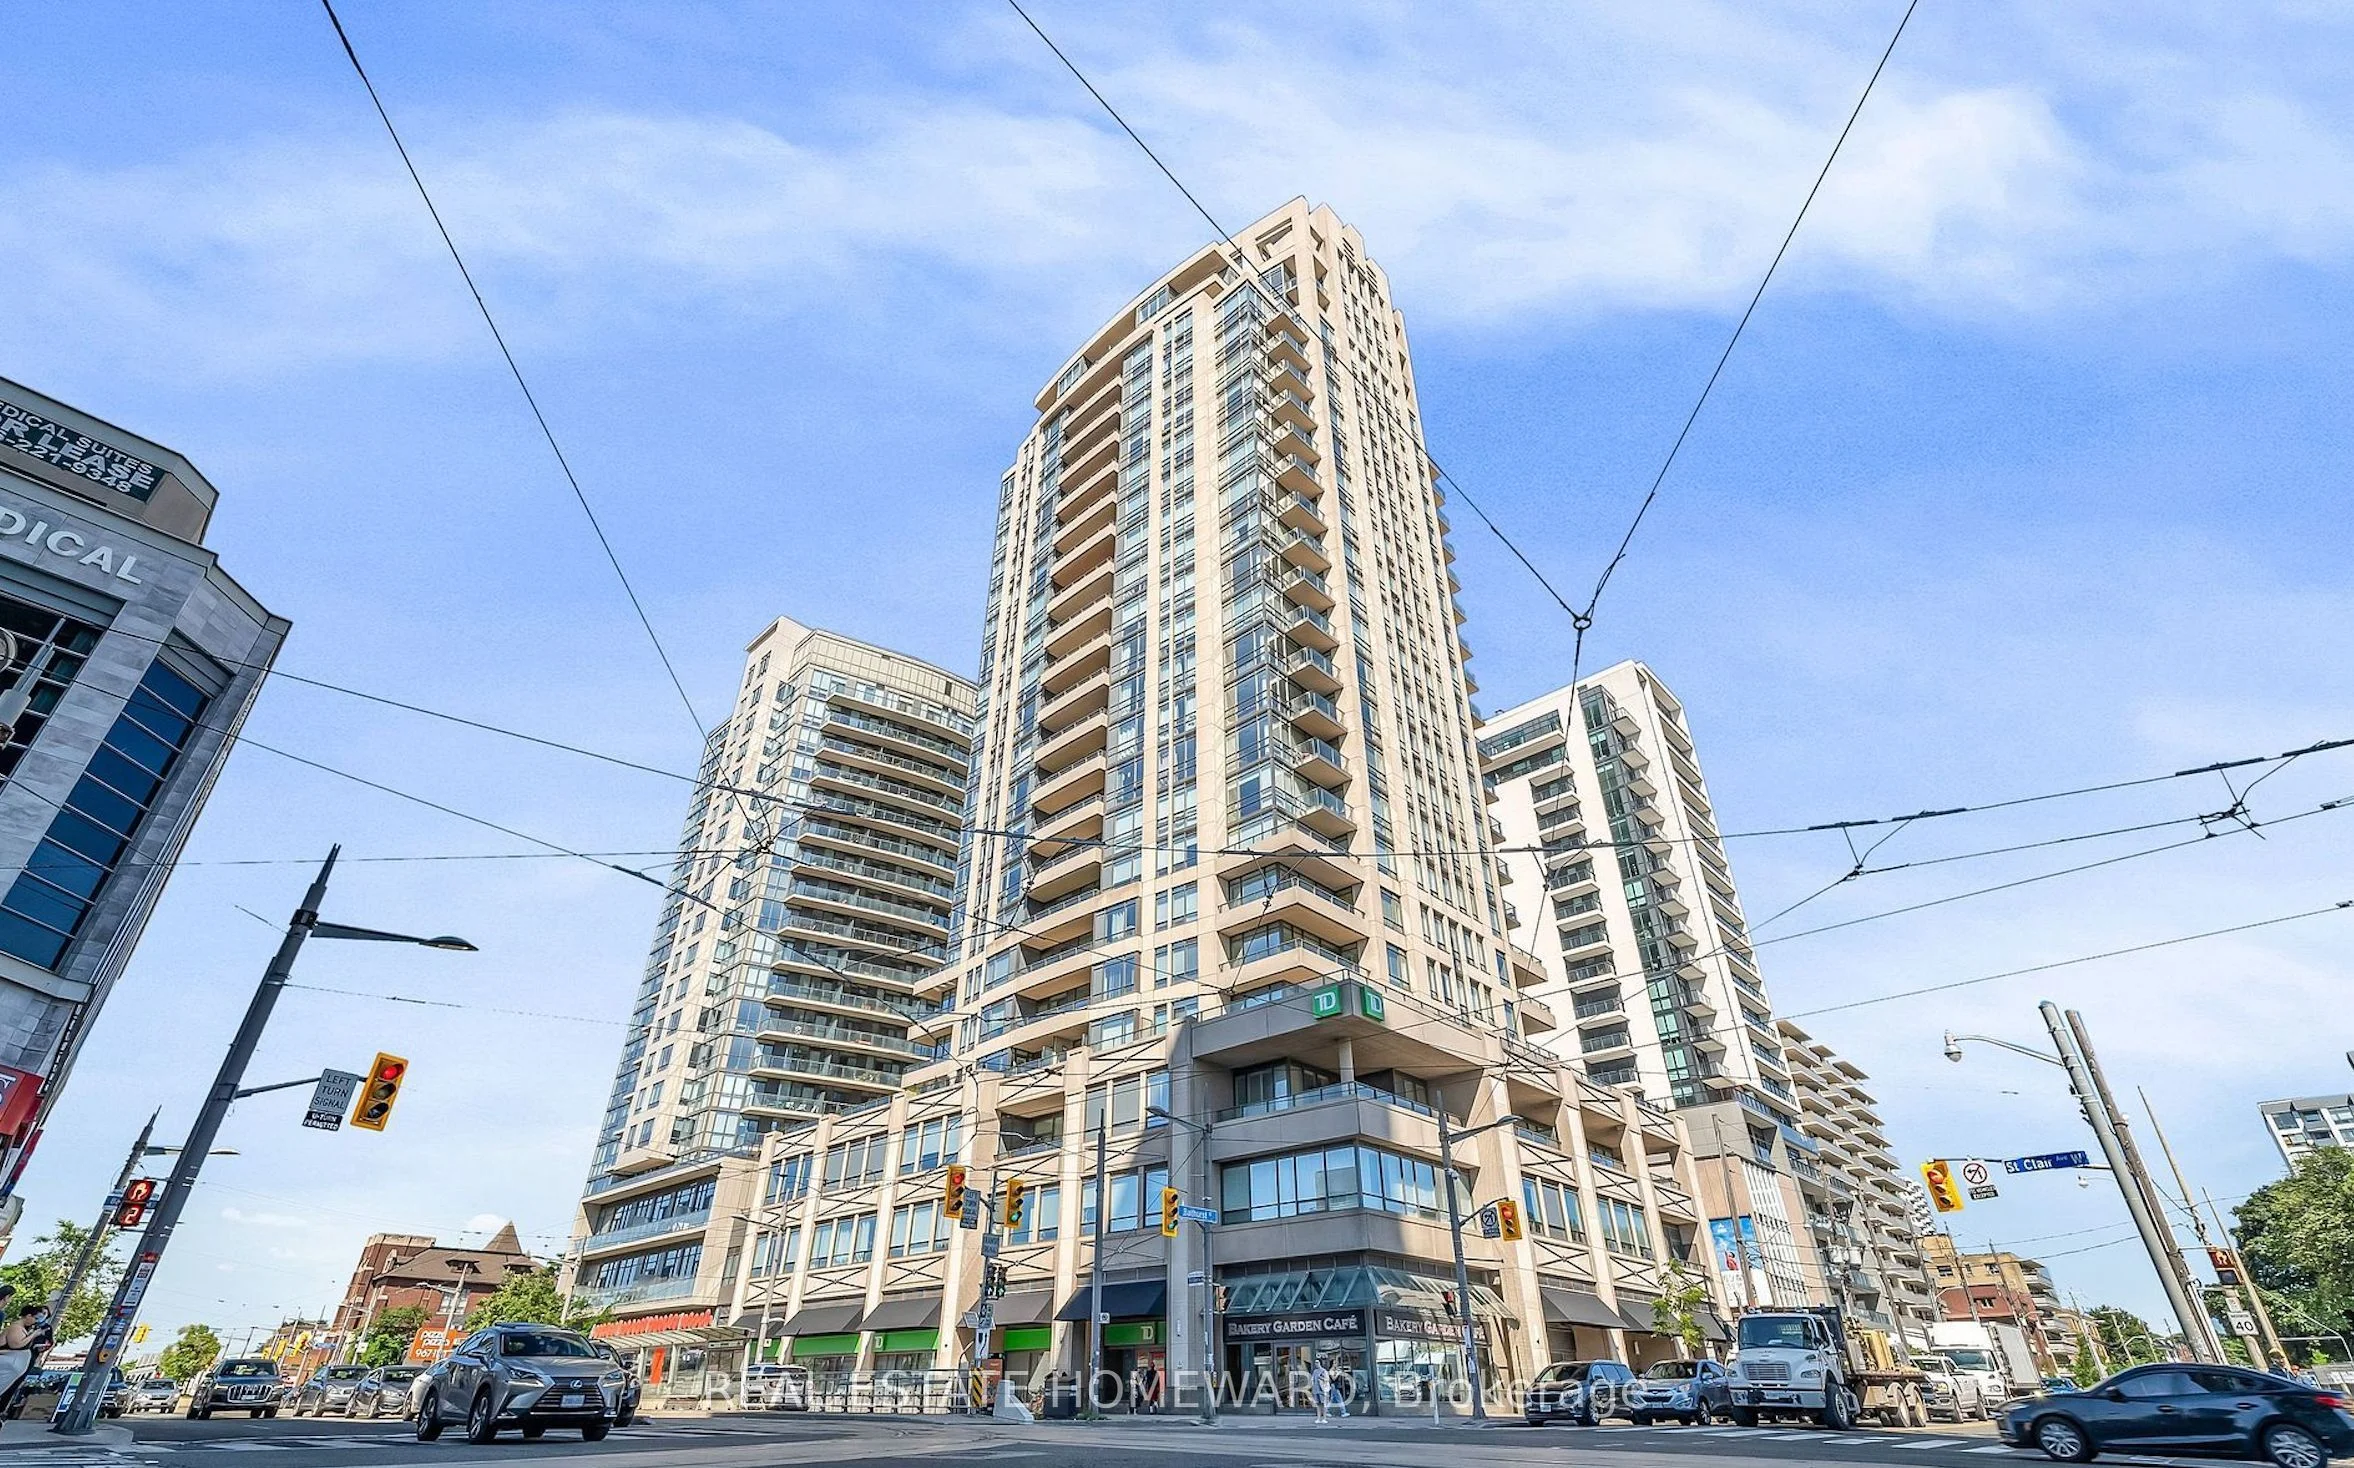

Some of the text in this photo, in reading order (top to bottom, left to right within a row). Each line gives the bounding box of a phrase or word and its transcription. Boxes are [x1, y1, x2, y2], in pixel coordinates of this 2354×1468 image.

[0, 413, 154, 490] R LEASE
[76, 436, 153, 475] SUITES
[1315, 991, 1336, 1011] TD
[1367, 993, 1382, 1013] TD
[327, 1074, 351, 1086] LEFT
[322, 1086, 348, 1097] TURN
[313, 1096, 344, 1109] SIGNAL
[2008, 1161, 2020, 1173] St
[2023, 1158, 2052, 1171] Clair
[124, 1208, 139, 1225] 2
[1140, 1326, 1154, 1340] TD
[1228, 1315, 1358, 1336] BAKERY GARDEN CAFÉ
[1385, 1316, 1423, 1333] BAKERY
[1424, 1320, 1462, 1337] GARDEN
[2236, 1321, 2253, 1332] 40
